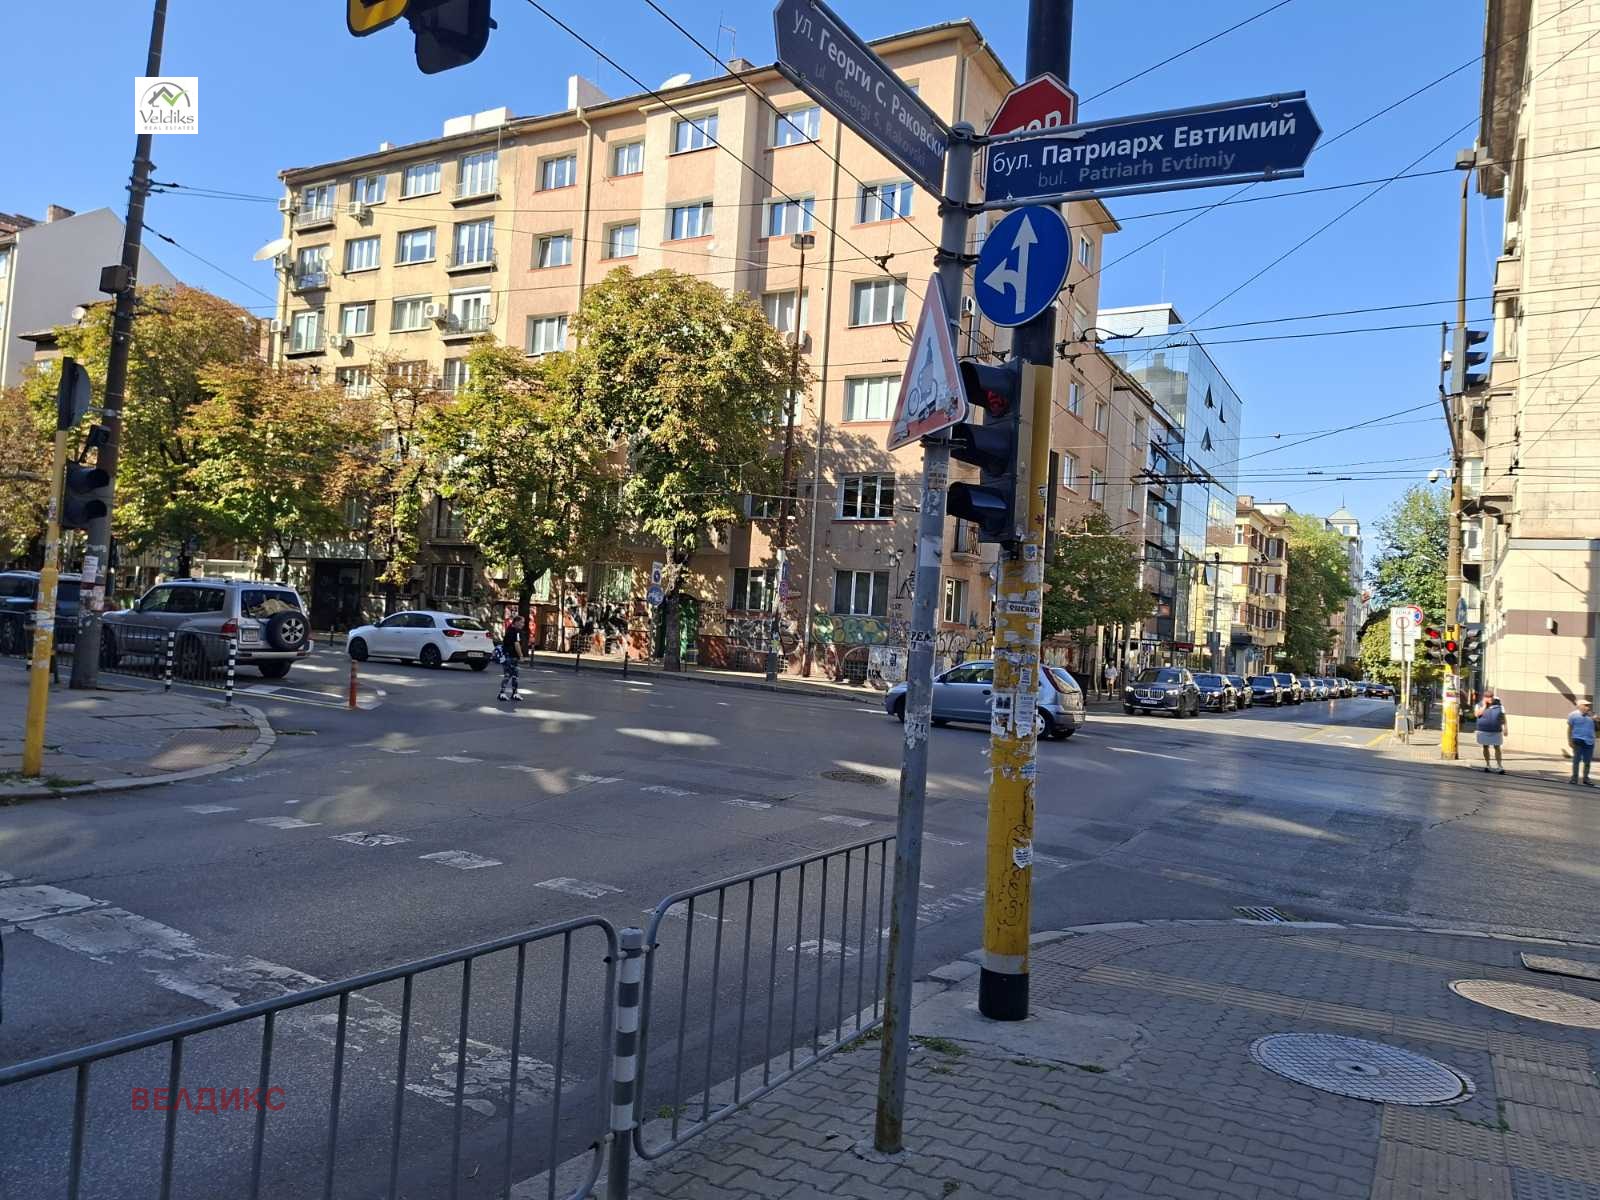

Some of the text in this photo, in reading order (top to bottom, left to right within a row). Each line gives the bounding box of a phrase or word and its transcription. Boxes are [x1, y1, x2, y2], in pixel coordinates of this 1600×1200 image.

[793, 9, 945, 160] ул. Георги С. Раковски
[835, 79, 872, 121] Georgi
[993, 113, 1297, 176] бул. Патриарх Евтимий
[1038, 150, 1236, 188] bul. Patriarh Evtimiy
